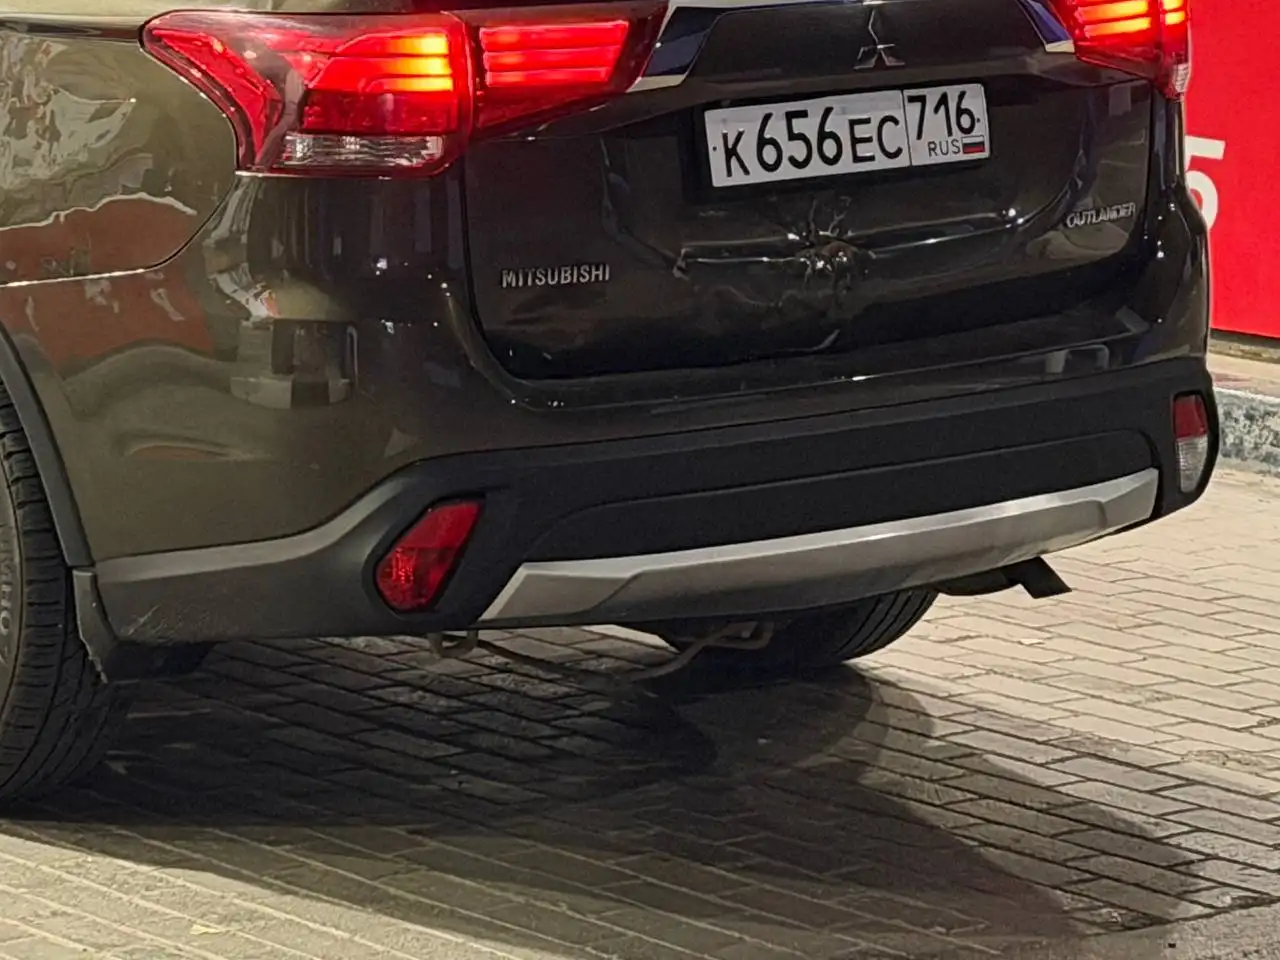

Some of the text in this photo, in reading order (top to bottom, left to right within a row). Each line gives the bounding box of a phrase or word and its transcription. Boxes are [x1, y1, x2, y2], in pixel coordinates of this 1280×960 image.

[907, 90, 976, 141] 716
[927, 140, 961, 157] RUS
[1066, 202, 1136, 228] OUTLANDER
[502, 264, 610, 288] MITSUBISHI
